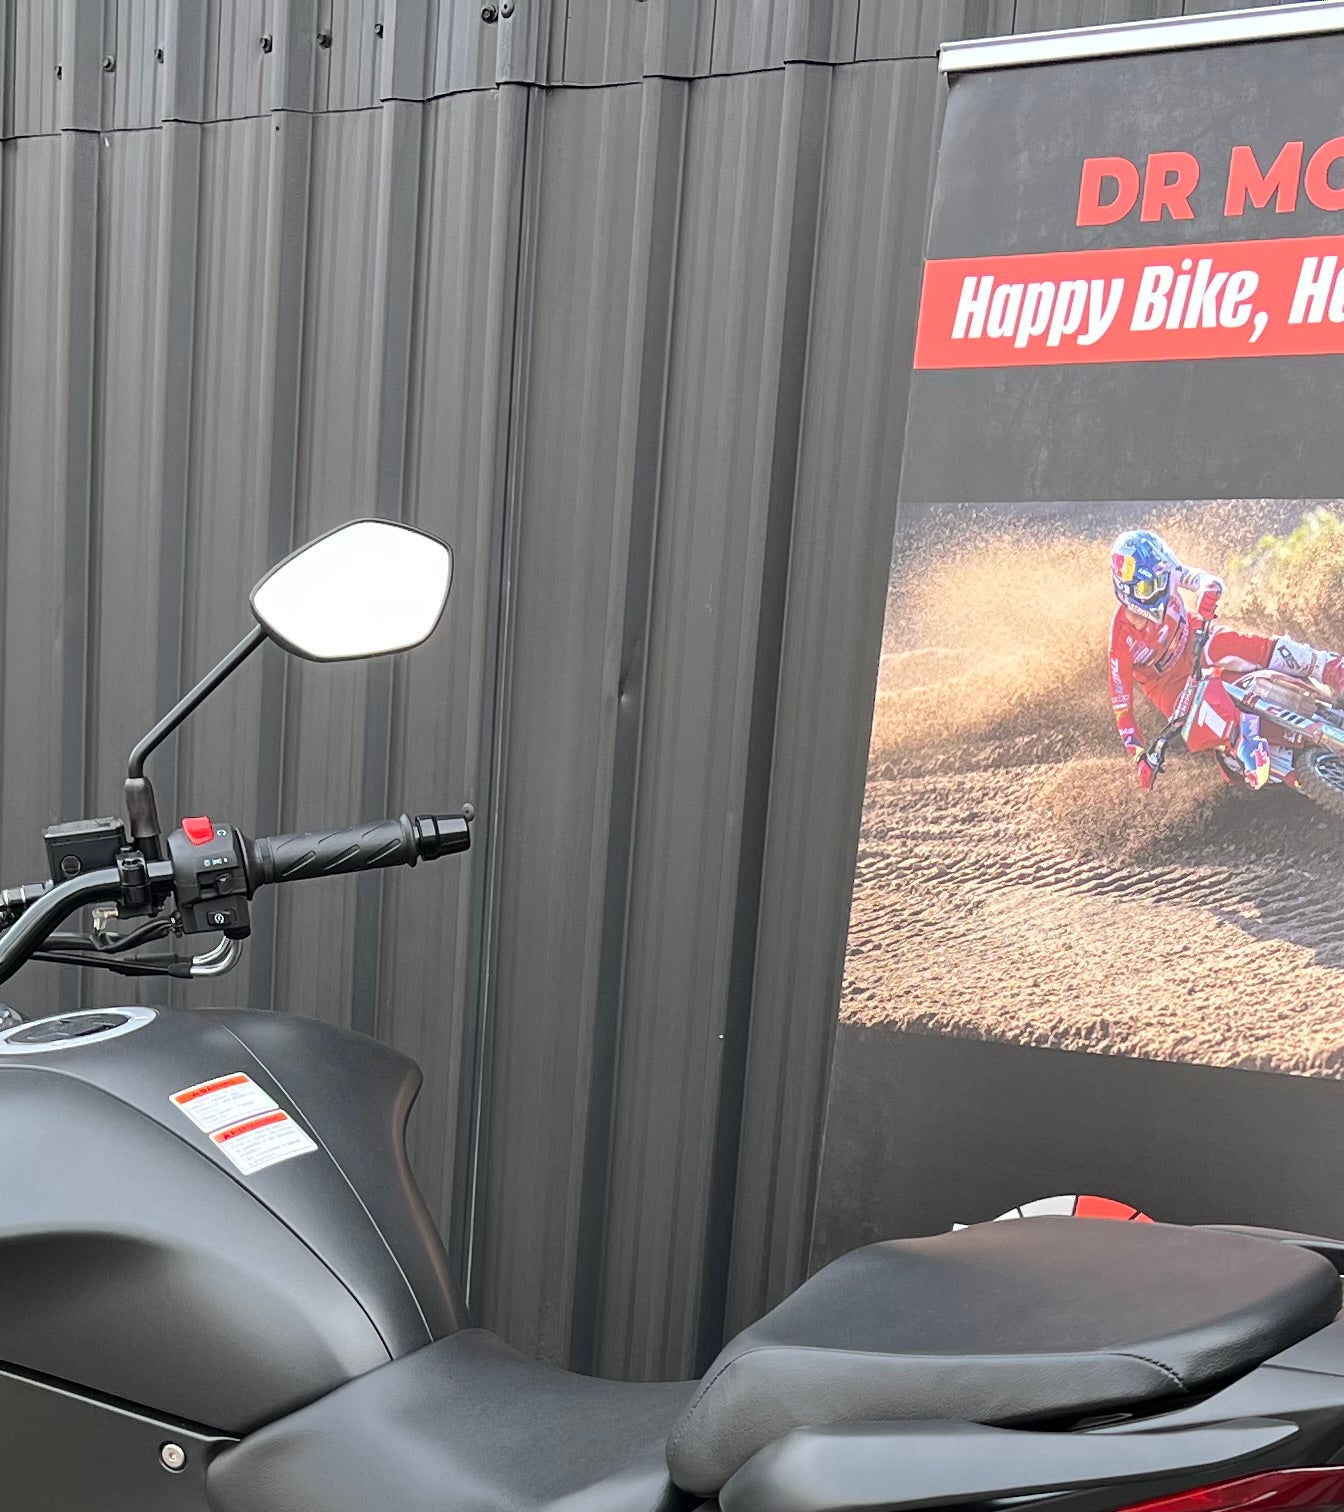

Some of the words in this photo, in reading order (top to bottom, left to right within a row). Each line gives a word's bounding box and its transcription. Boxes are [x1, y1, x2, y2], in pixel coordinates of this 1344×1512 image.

[1076, 152, 1200, 227] DR
[951, 275, 1124, 348] Happy
[1130, 258, 1269, 342] Bike,
